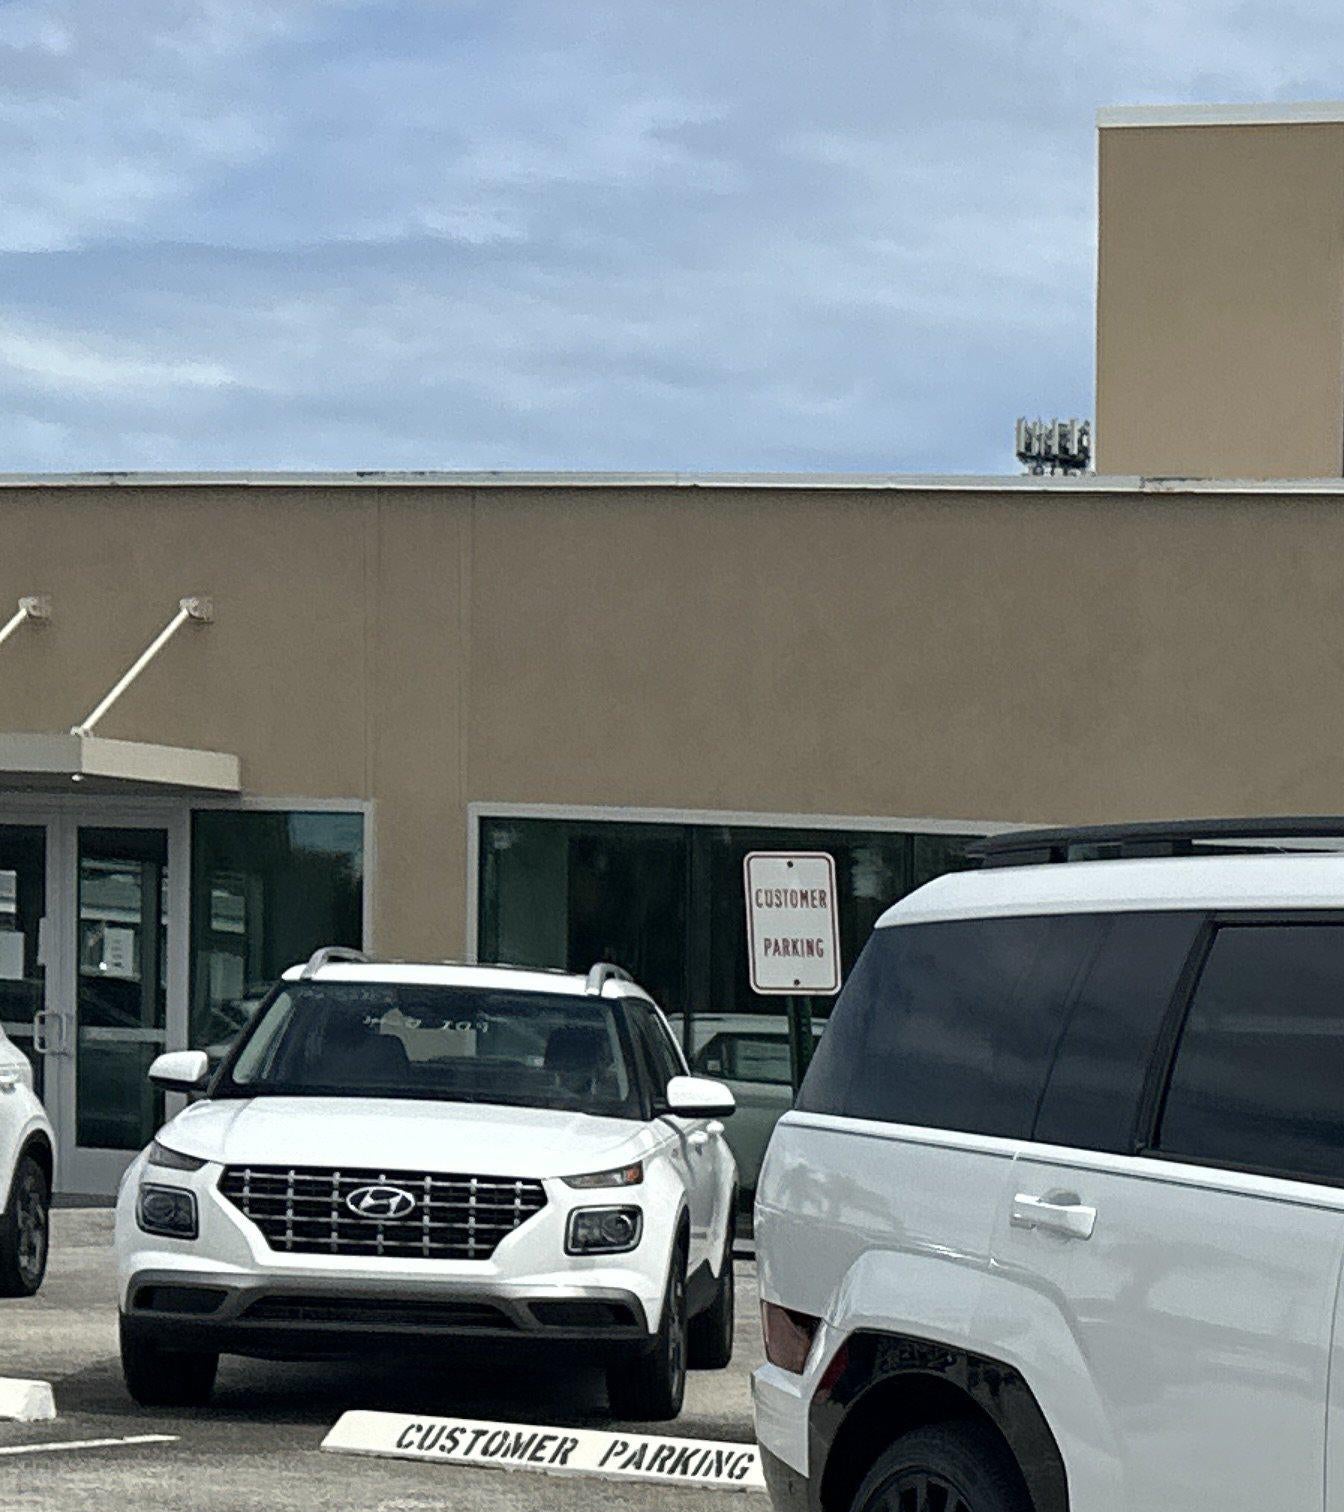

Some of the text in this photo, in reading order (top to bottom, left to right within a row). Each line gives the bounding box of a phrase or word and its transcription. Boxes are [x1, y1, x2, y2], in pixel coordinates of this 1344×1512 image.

[755, 888, 828, 909] CUSTOMER
[763, 938, 824, 958] PARKING
[395, 1423, 755, 1481] CUSTOMER PARKING
